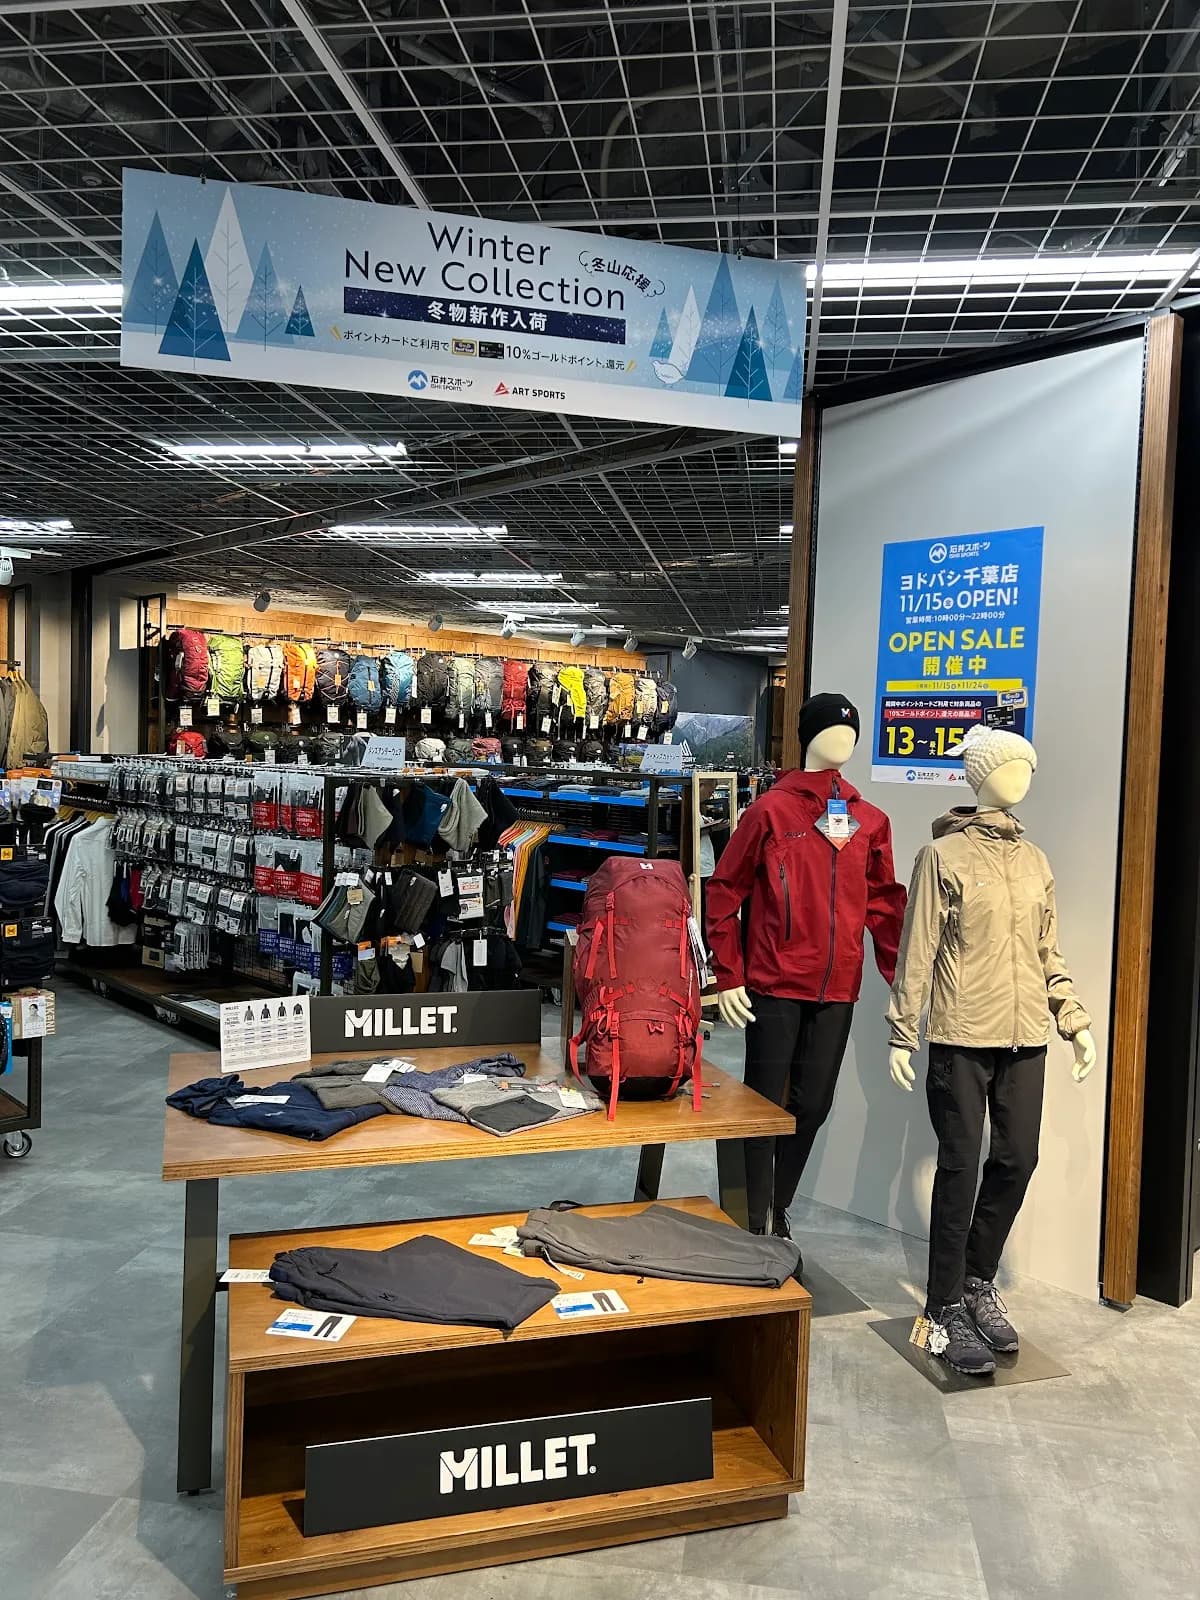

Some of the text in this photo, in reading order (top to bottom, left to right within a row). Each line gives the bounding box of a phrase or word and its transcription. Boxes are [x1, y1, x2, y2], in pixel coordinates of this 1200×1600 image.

[427, 221, 551, 266] Winter
[345, 248, 625, 311] New Collection
[591, 257, 652, 293] 冬山応援
[427, 300, 548, 332] 冬物新作入荷
[343, 329, 450, 351] ポイントカードご利用で
[430, 375, 473, 387] 石井スポーツ
[512, 386, 566, 400] ART SPORTS
[949, 541, 991, 554] 石井スポーツ
[900, 563, 1020, 591] ヨドバシ千葉店
[956, 586, 1019, 609] OPEN!
[888, 626, 1025, 653] OPEN SALE
[922, 654, 987, 677] 開催中
